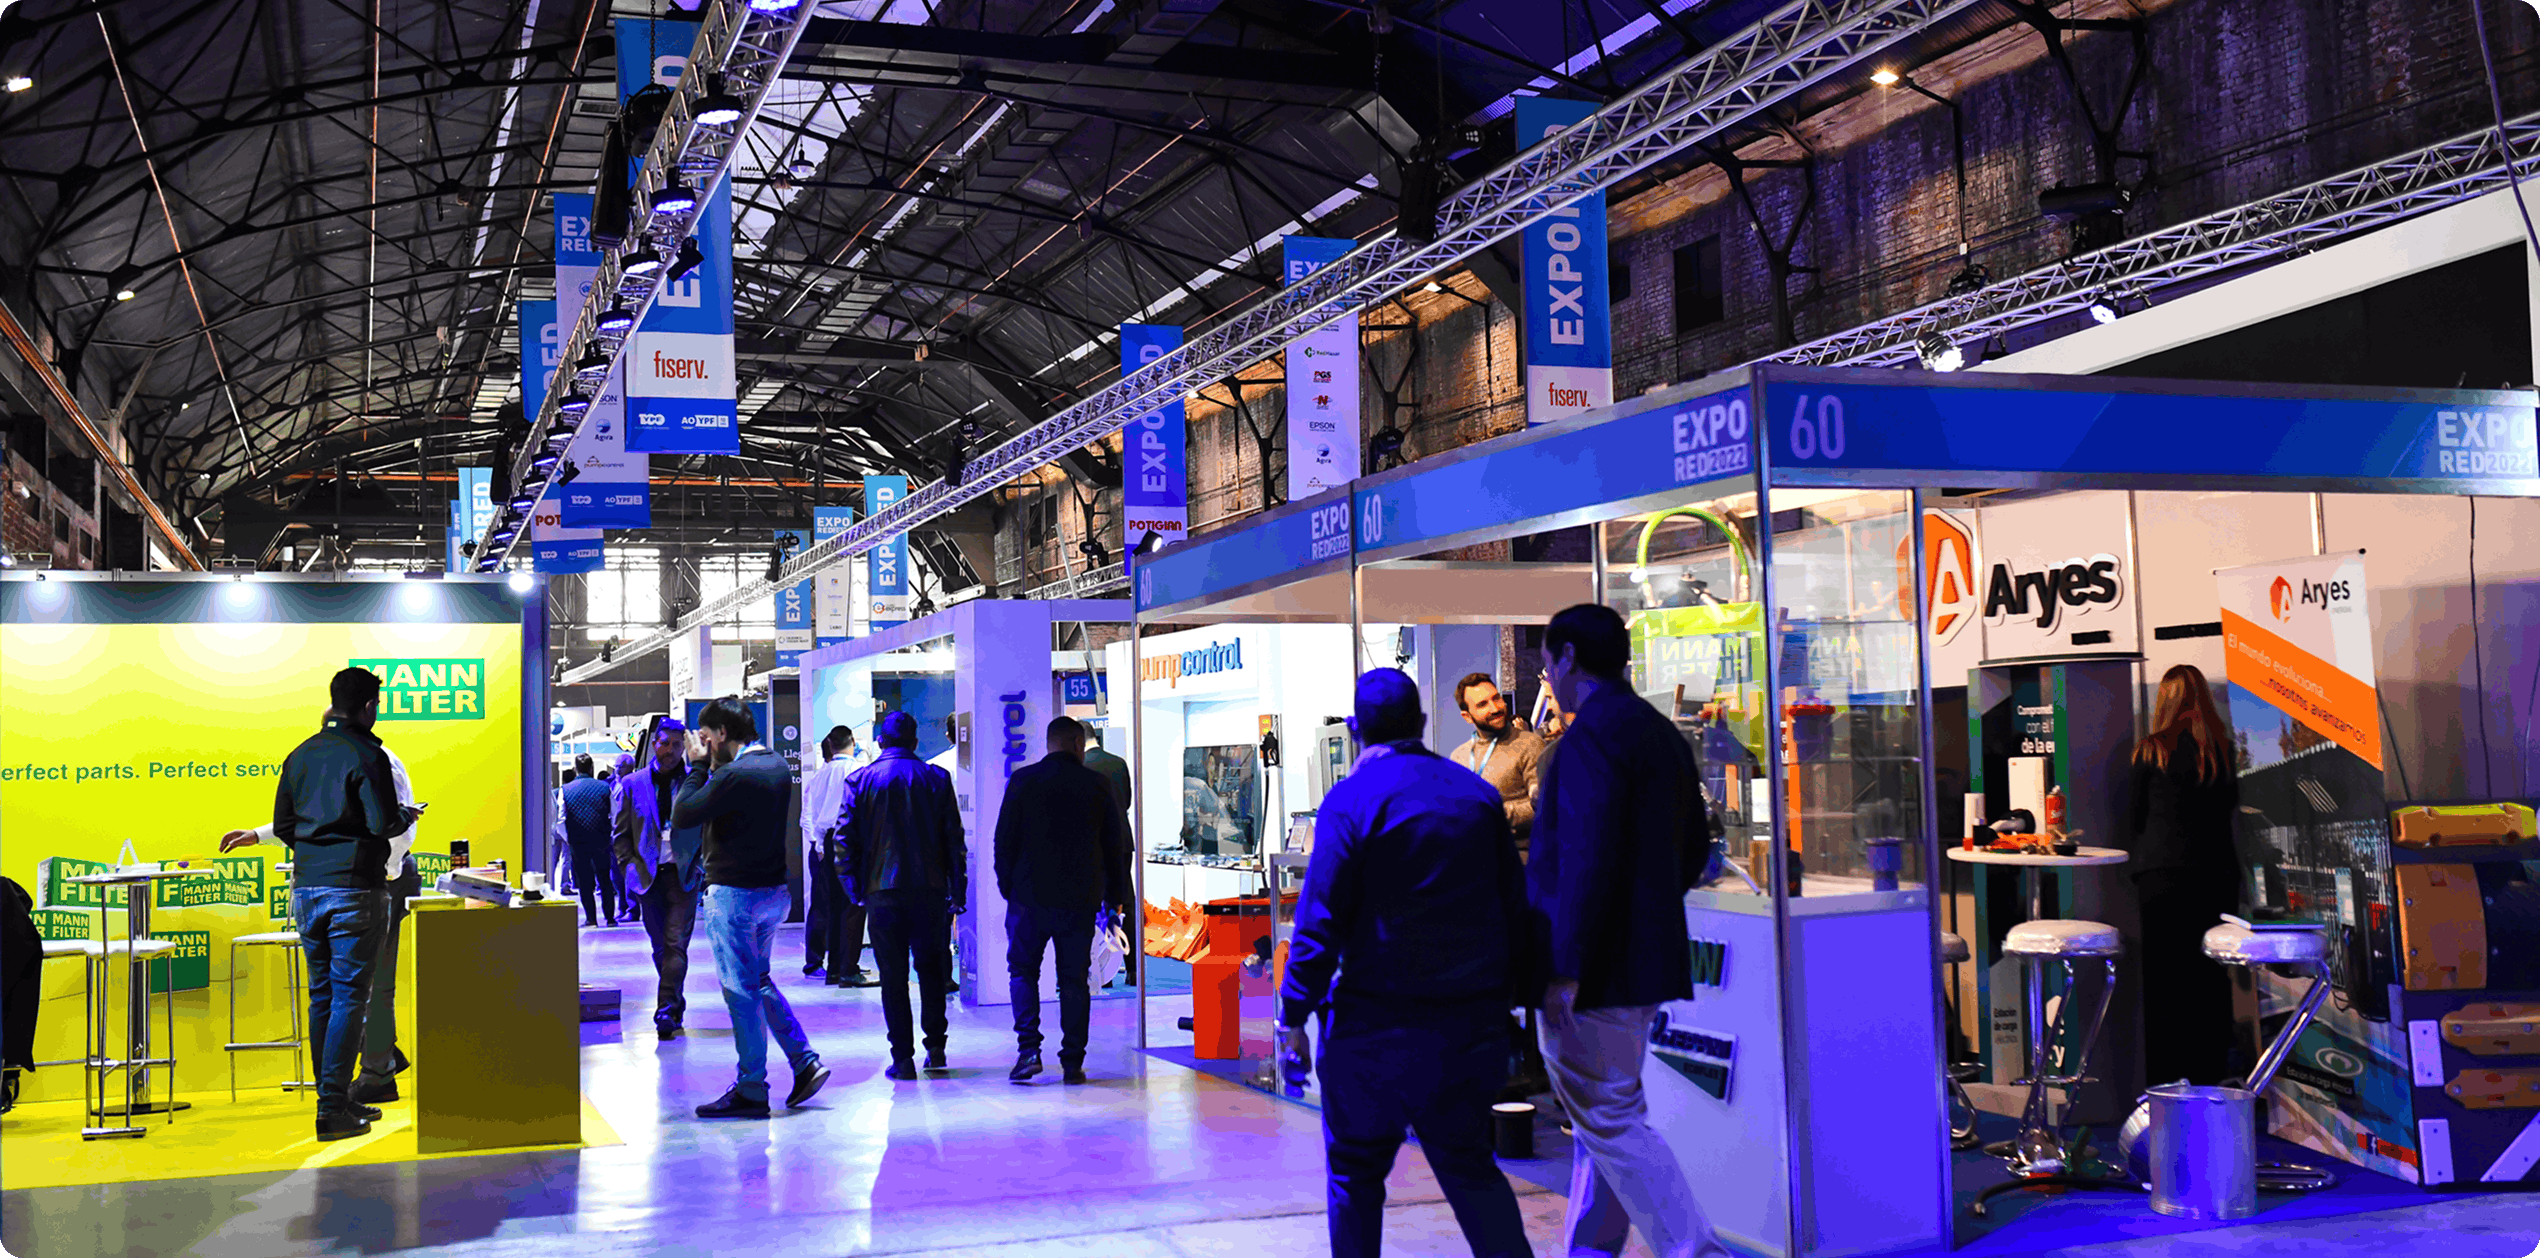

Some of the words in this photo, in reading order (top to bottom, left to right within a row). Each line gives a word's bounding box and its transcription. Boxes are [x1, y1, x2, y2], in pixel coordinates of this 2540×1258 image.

[653, 349, 709, 380] fiserv.
[1548, 382, 1591, 408] fiserv.
[1309, 421, 1336, 430] EPSON
[1672, 398, 1748, 454] EXPO
[1789, 394, 1847, 460] 60
[1673, 442, 1749, 483] RED2022
[2439, 449, 2534, 474] RED2022
[816, 516, 851, 527] EXPO
[1128, 518, 1183, 532] POTIGIAN
[1310, 502, 1349, 541] EXPO
[1362, 493, 1383, 544] 60
[1310, 531, 1350, 561] RED2022
[1139, 567, 1152, 607] 60
[1984, 560, 2118, 629] Aryes
[2300, 577, 2351, 611] Aryes
[1070, 678, 1089, 698] 55
[378, 690, 478, 714] ILTER
[2020, 736, 2034, 754] de
[2034, 736, 2045, 754] la
[75, 763, 141, 785] parts.
[149, 761, 229, 779] Perfect
[417, 856, 451, 871] MAN
[183, 883, 221, 896] MANN
[183, 892, 221, 905] FILTER
[224, 883, 249, 895] MANN
[224, 892, 248, 904] FILTER
[52, 912, 89, 927] MANN
[52, 925, 88, 939] FILTER
[171, 946, 207, 959] LTER
